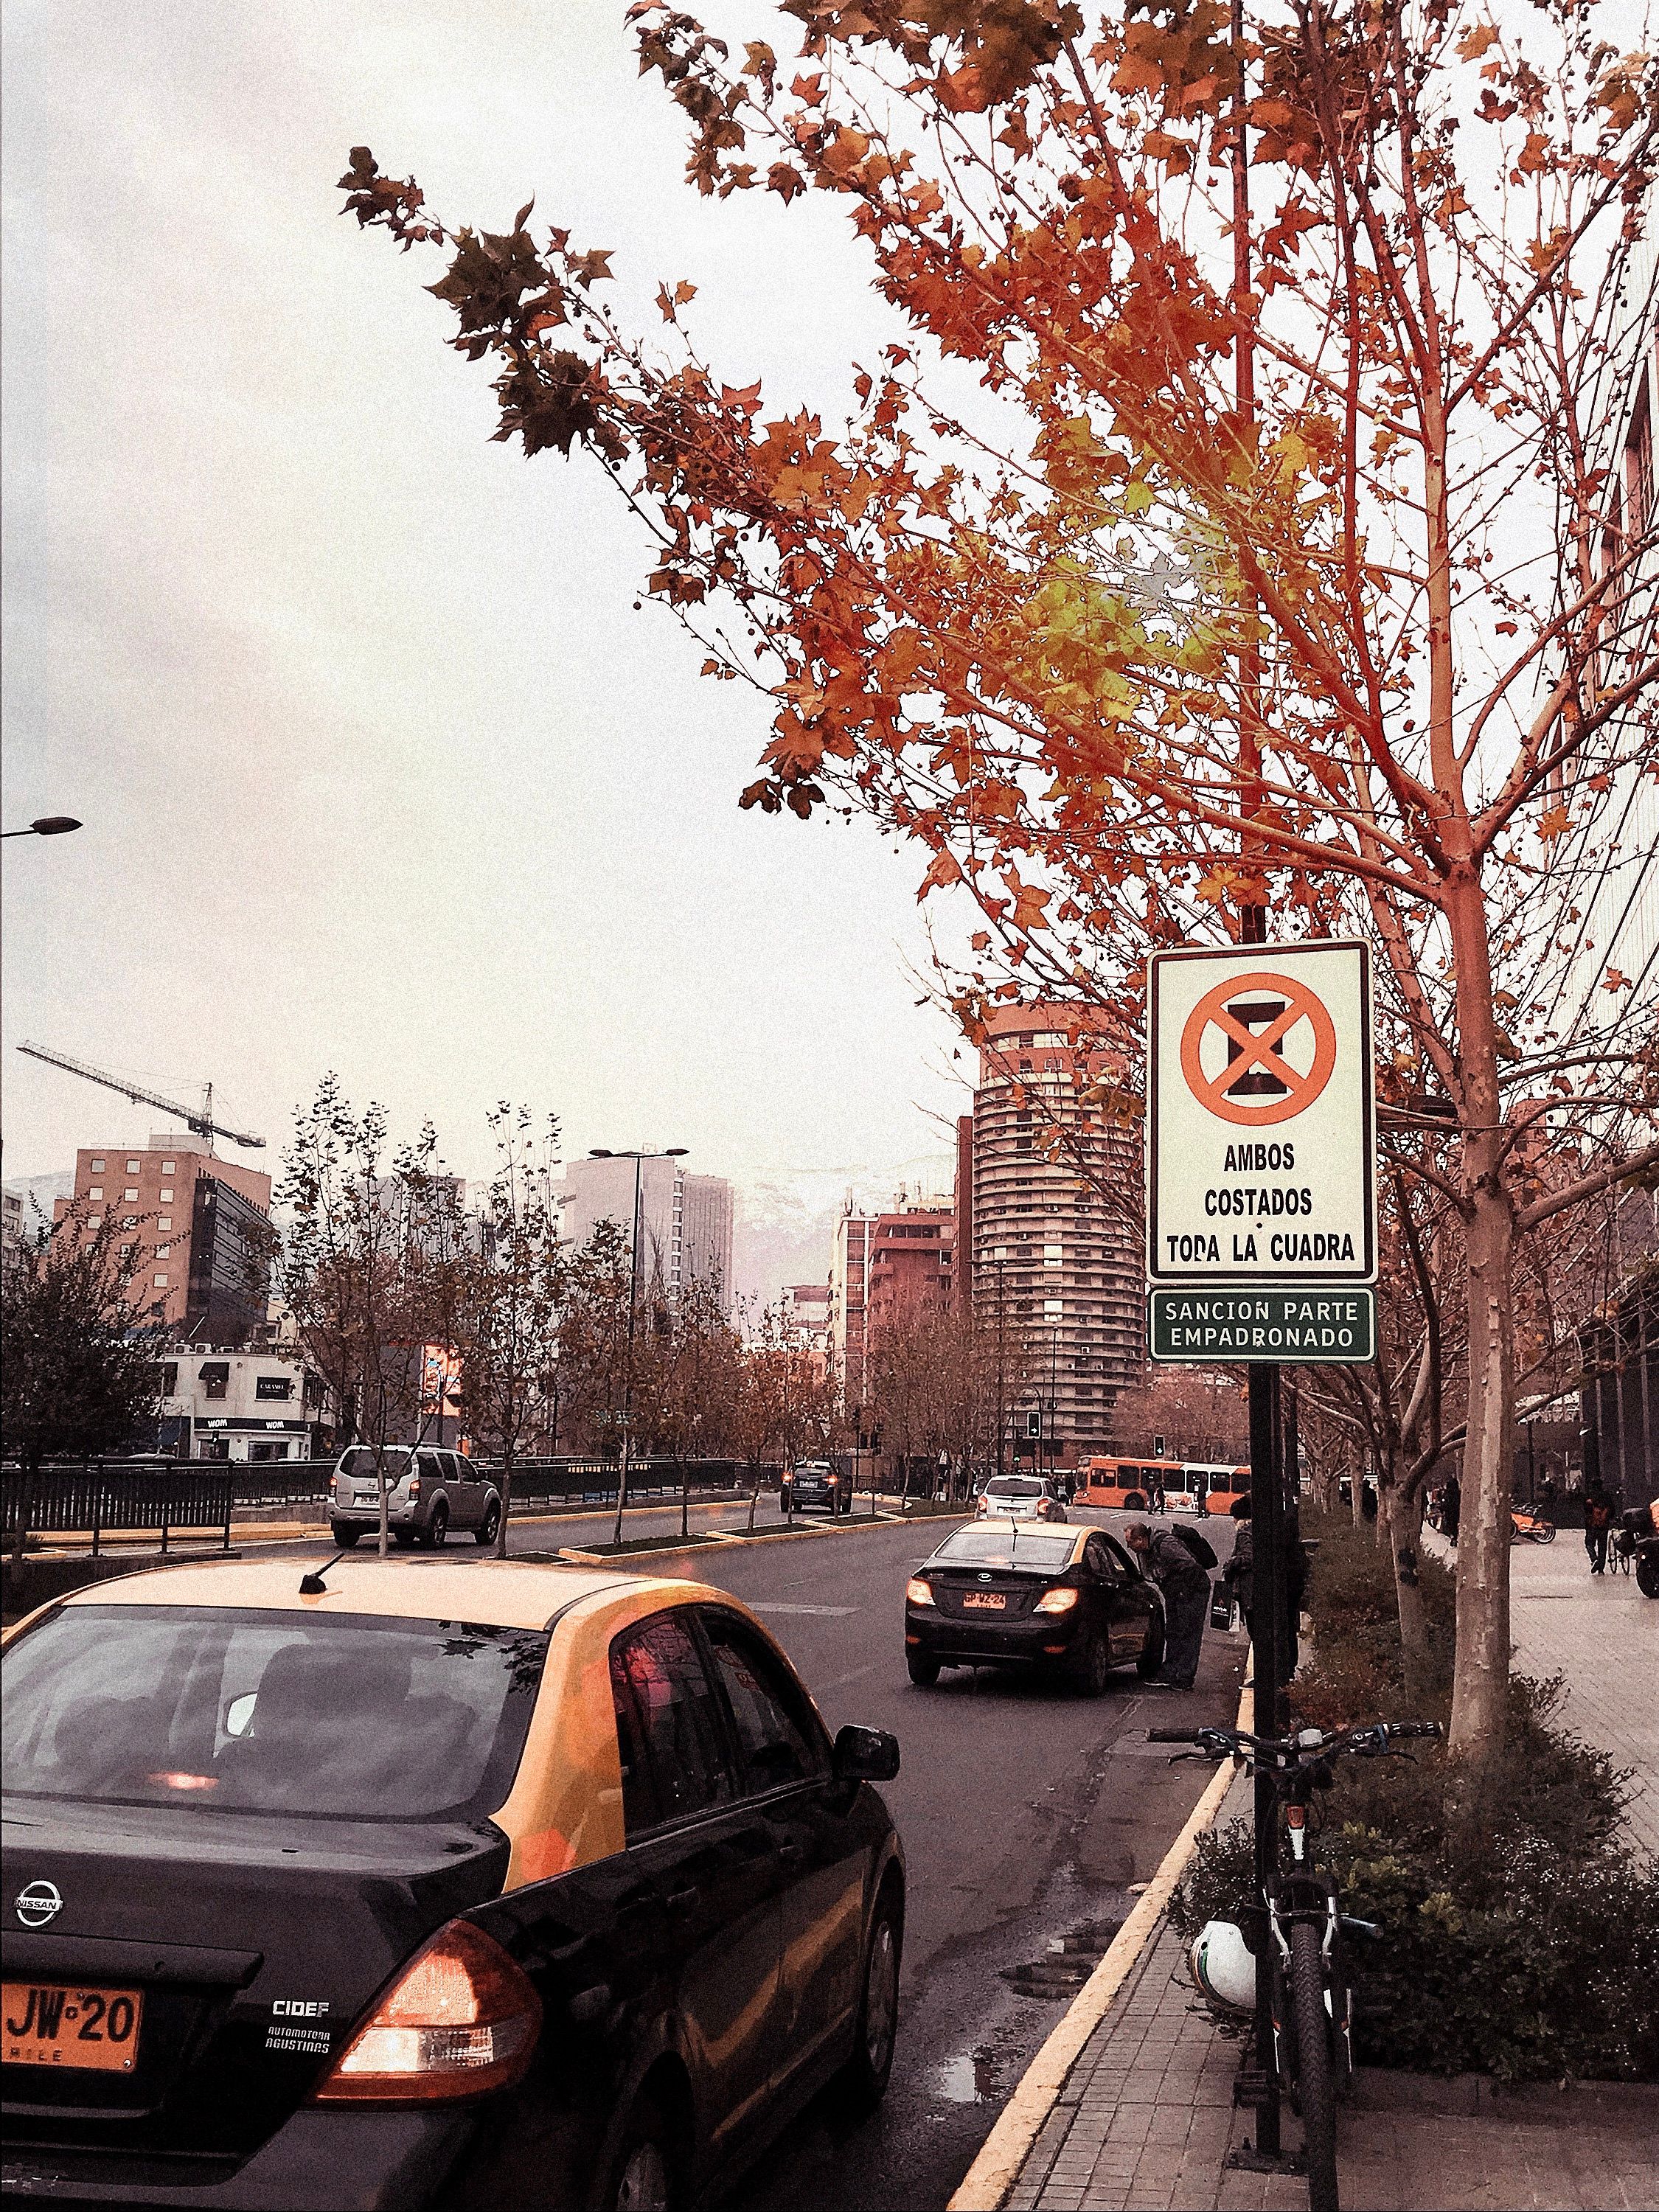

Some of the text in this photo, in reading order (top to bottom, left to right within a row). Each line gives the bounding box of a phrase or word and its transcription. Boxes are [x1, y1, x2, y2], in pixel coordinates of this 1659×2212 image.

[1224, 1143, 1295, 1172] AMBOS
[1204, 1188, 1312, 1217] COSTADOS
[1166, 1234, 1355, 1262] TODA LA CUADRA
[1165, 1301, 1358, 1321] SANCION PARTE
[1171, 1327, 1353, 1347] EMPADRONADO
[207, 1419, 285, 1430] WOM WOM
[16, 1899, 57, 1910] NISSAN
[272, 2000, 330, 2017] CIDEF
[268, 2026, 330, 2041] AUTOMOTORA
[265, 2037, 330, 2053] AGUSTINAS
